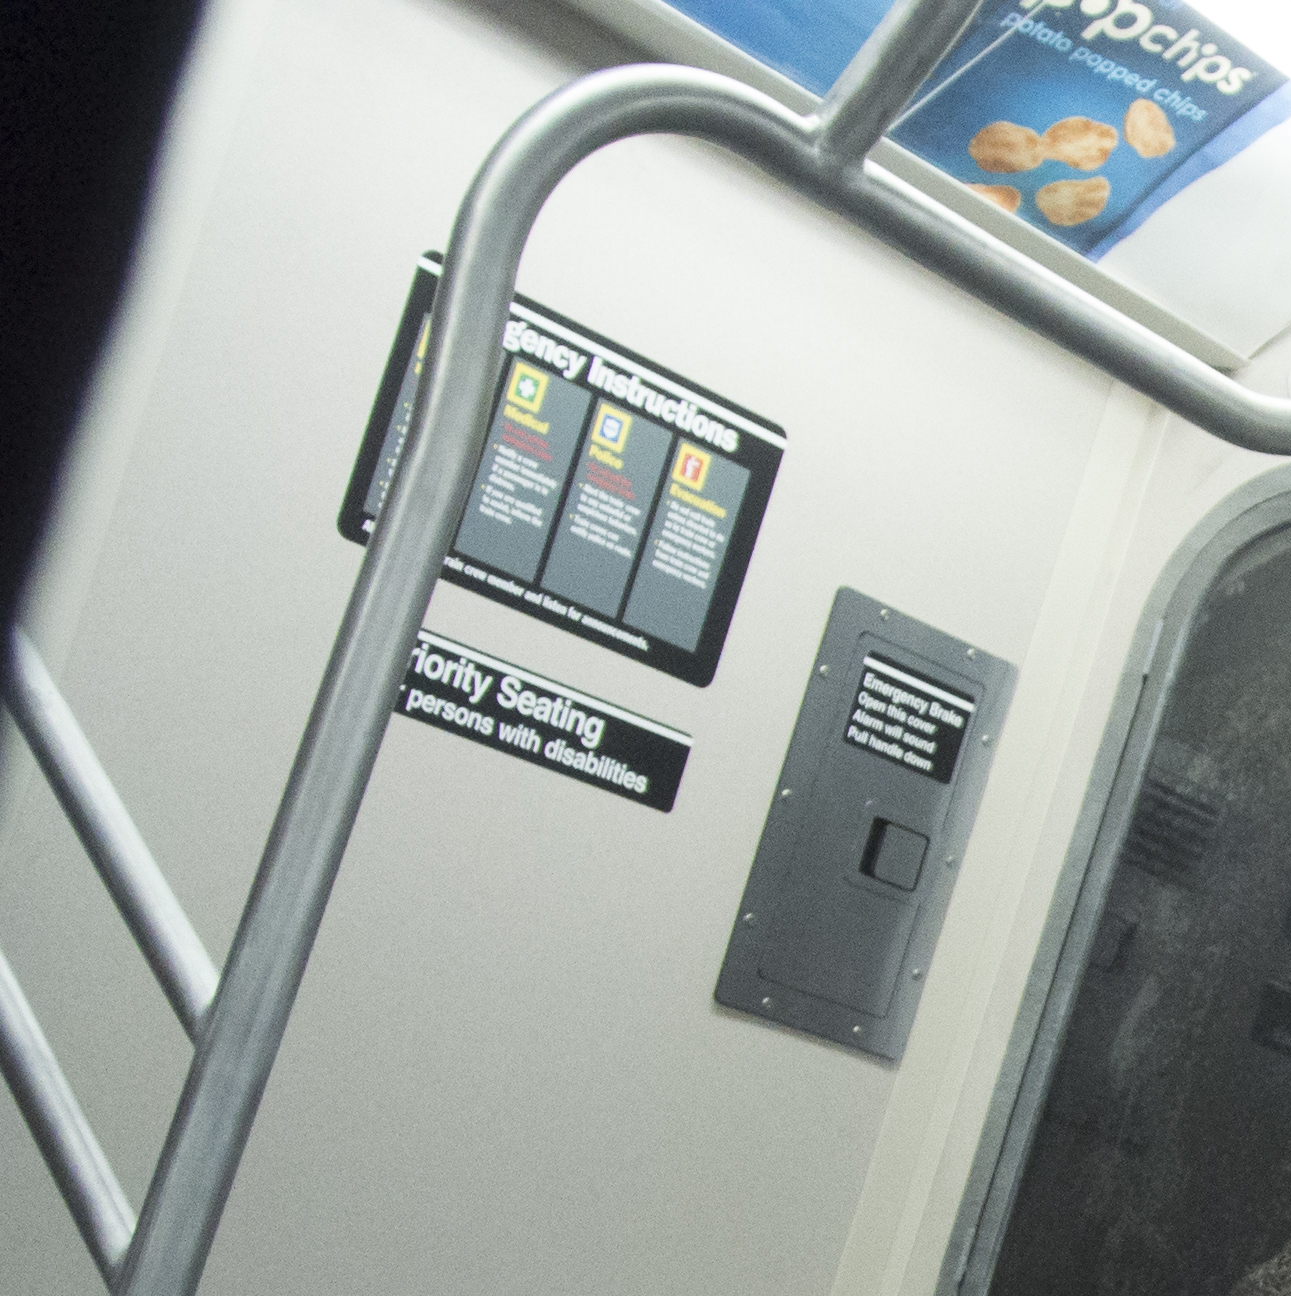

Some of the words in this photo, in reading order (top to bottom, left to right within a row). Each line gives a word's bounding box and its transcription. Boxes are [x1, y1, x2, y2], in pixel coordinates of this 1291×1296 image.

[1000, 11, 1073, 51] potato
[1068, 45, 1158, 94] popped
[1153, 86, 1208, 123] chips
[1019, 0, 1252, 96] pchips
[501, 319, 588, 382] gency
[586, 355, 740, 453] Instructions
[589, 443, 624, 470] Police
[669, 482, 727, 518] Evacuation
[443, 556, 464, 572] rain
[463, 563, 487, 581] crew
[486, 573, 524, 597] member
[524, 590, 543, 606] and
[411, 642, 493, 704] iority
[496, 675, 606, 748] Seating
[858, 691, 888, 713] Open
[886, 703, 907, 722] this
[907, 714, 938, 735] cover
[863, 671, 930, 715] Emergency
[929, 701, 964, 729] Brake
[406, 687, 495, 737] persons
[498, 720, 542, 754] with
[543, 736, 649, 794] disabilities
[847, 724, 869, 745] Pull
[868, 733, 904, 760] handle
[903, 750, 934, 772] down
[852, 708, 885, 732] Alarm
[884, 723, 904, 740] will
[902, 732, 938, 755] sound
